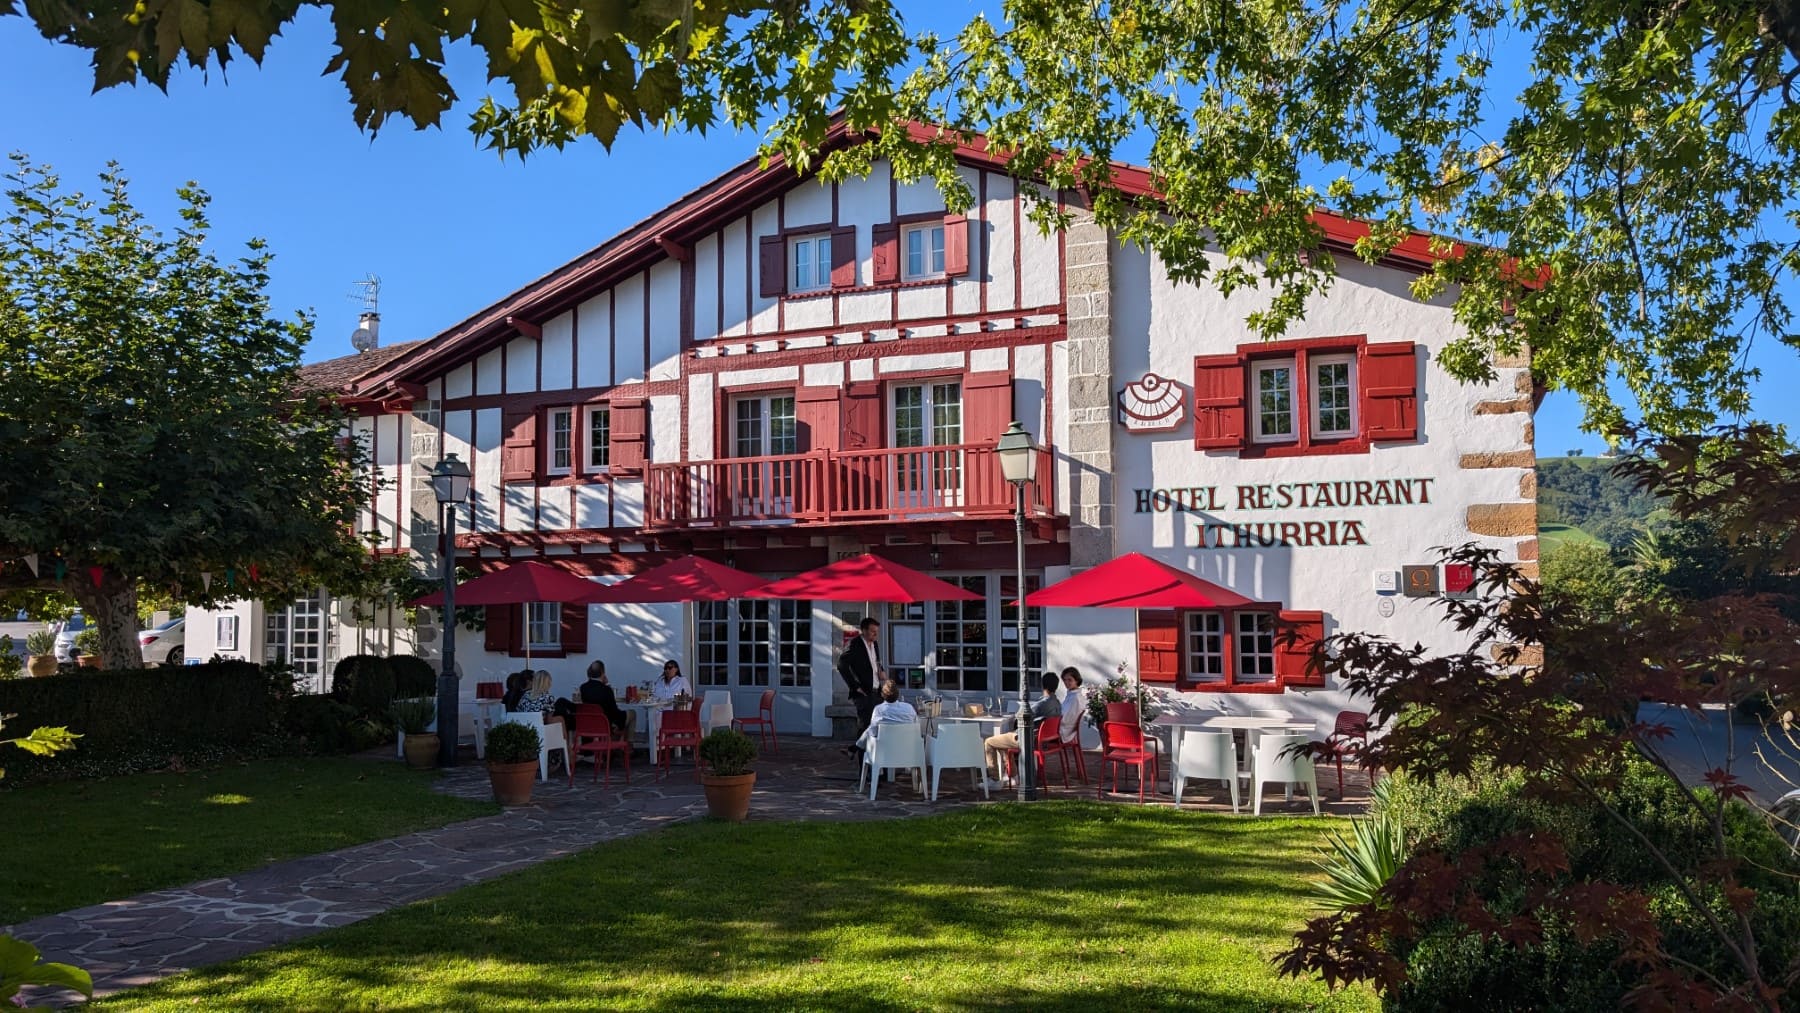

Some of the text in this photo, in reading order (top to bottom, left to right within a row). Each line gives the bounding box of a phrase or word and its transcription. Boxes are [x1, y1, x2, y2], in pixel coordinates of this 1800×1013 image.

[1134, 477, 1435, 513] HOTEL RESTAURANT
[1196, 520, 1369, 548] ITHURRIA
